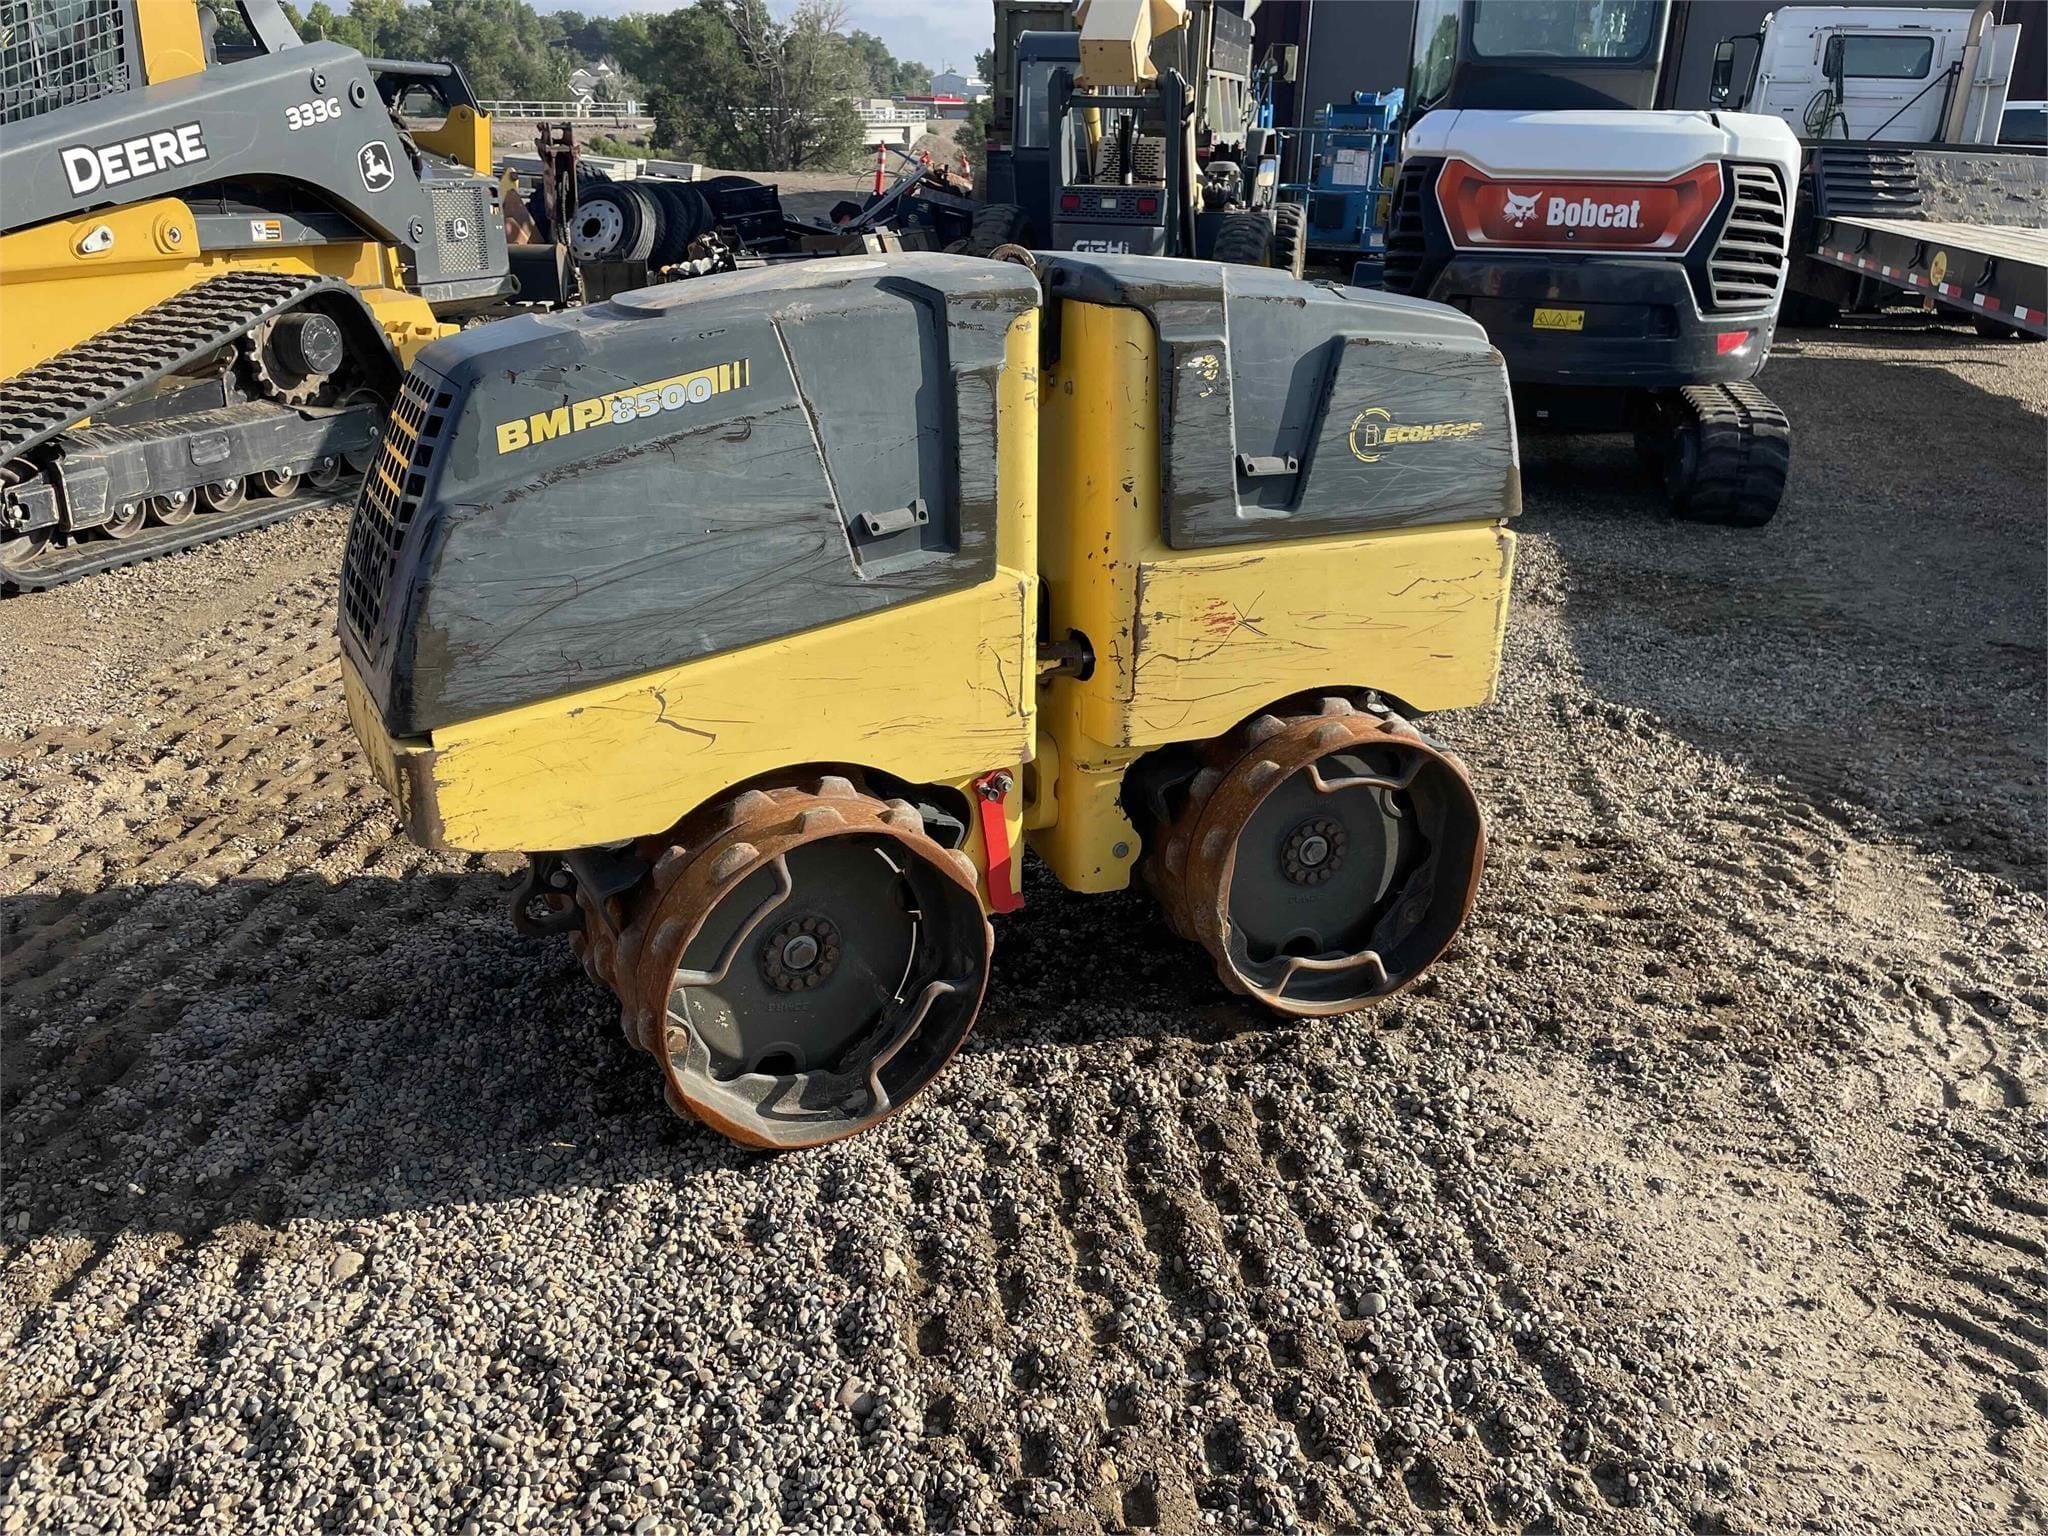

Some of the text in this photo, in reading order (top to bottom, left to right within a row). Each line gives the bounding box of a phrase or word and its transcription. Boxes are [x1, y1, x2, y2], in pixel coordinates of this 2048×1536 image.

[285, 97, 342, 131] 333G
[61, 123, 208, 195] DEERE
[1546, 197, 1641, 228] Bobcat
